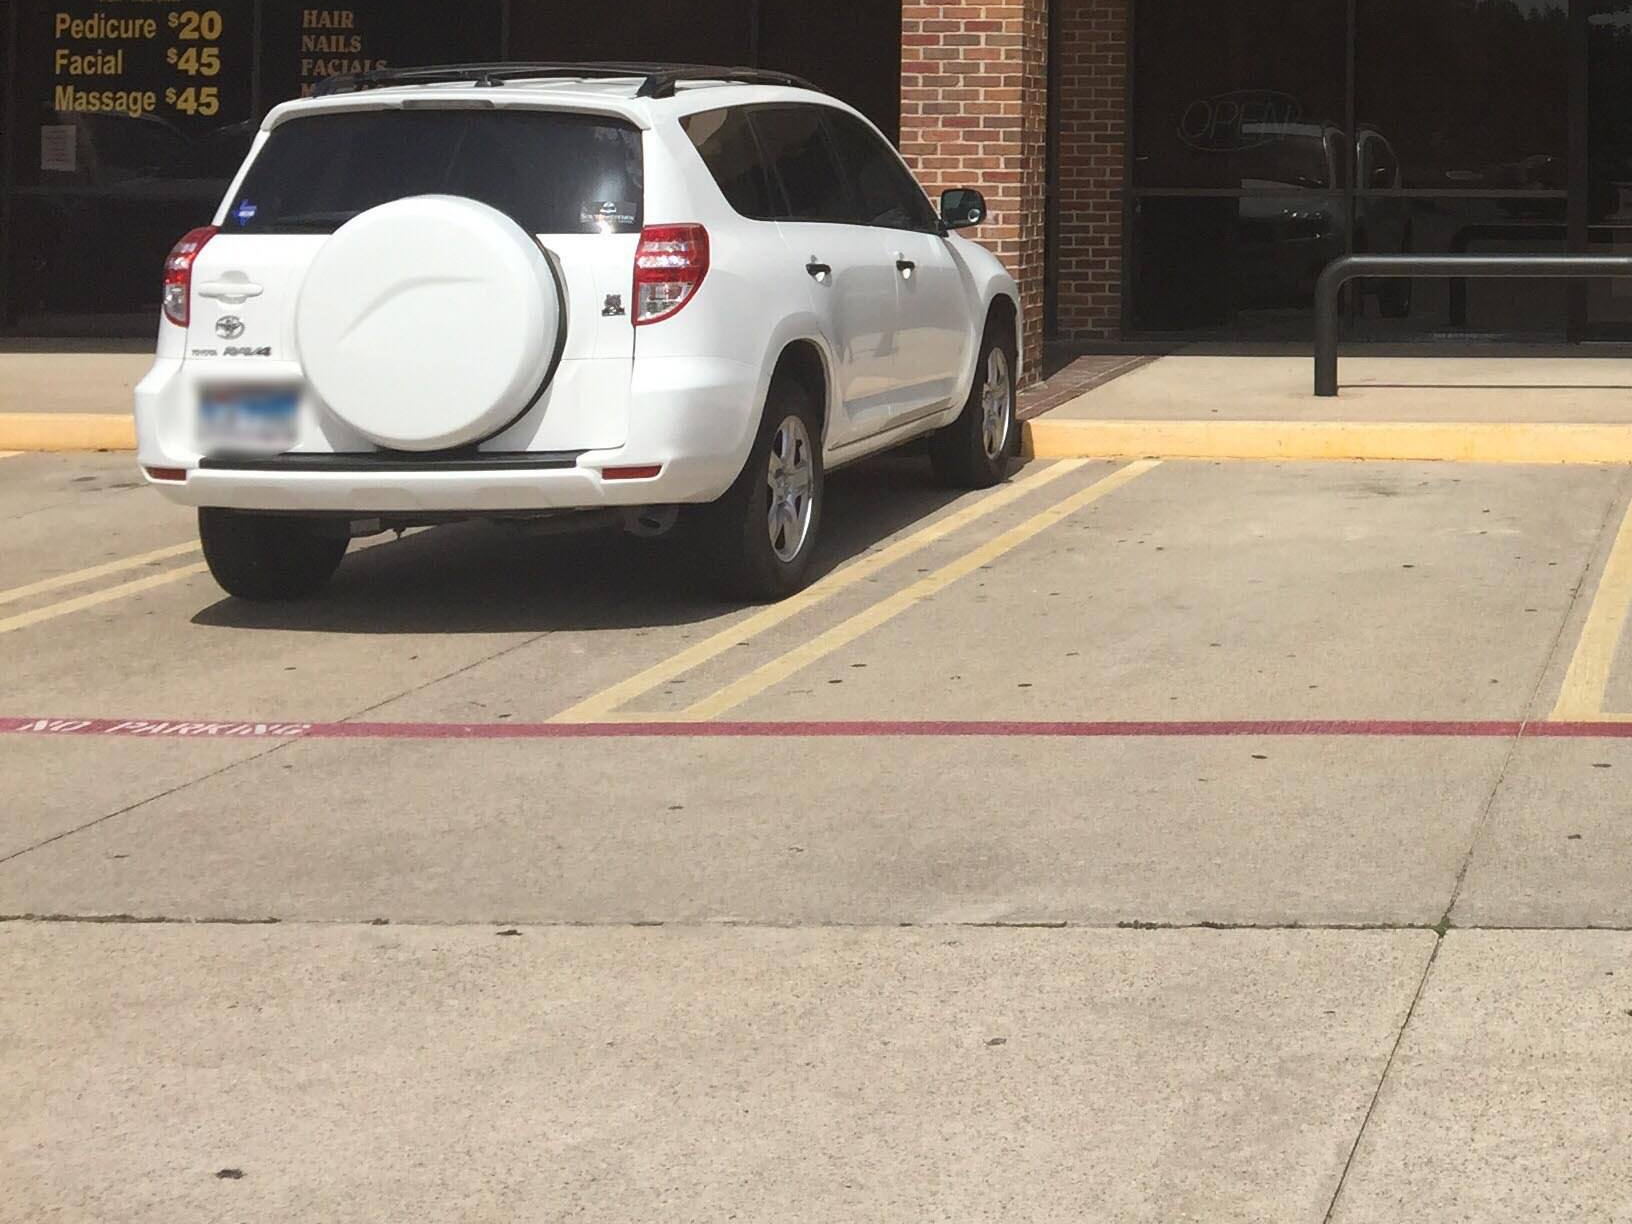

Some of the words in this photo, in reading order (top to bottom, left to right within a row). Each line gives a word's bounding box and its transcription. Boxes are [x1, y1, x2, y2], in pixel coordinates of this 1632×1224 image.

[55, 12, 157, 39] Pedicure
[168, 10, 223, 40] $20
[302, 9, 354, 28] HAIR
[301, 35, 361, 52] NAILS
[55, 49, 123, 75] Facial
[166, 47, 221, 76] $45
[54, 84, 156, 118] Massage
[165, 86, 220, 116] $45
